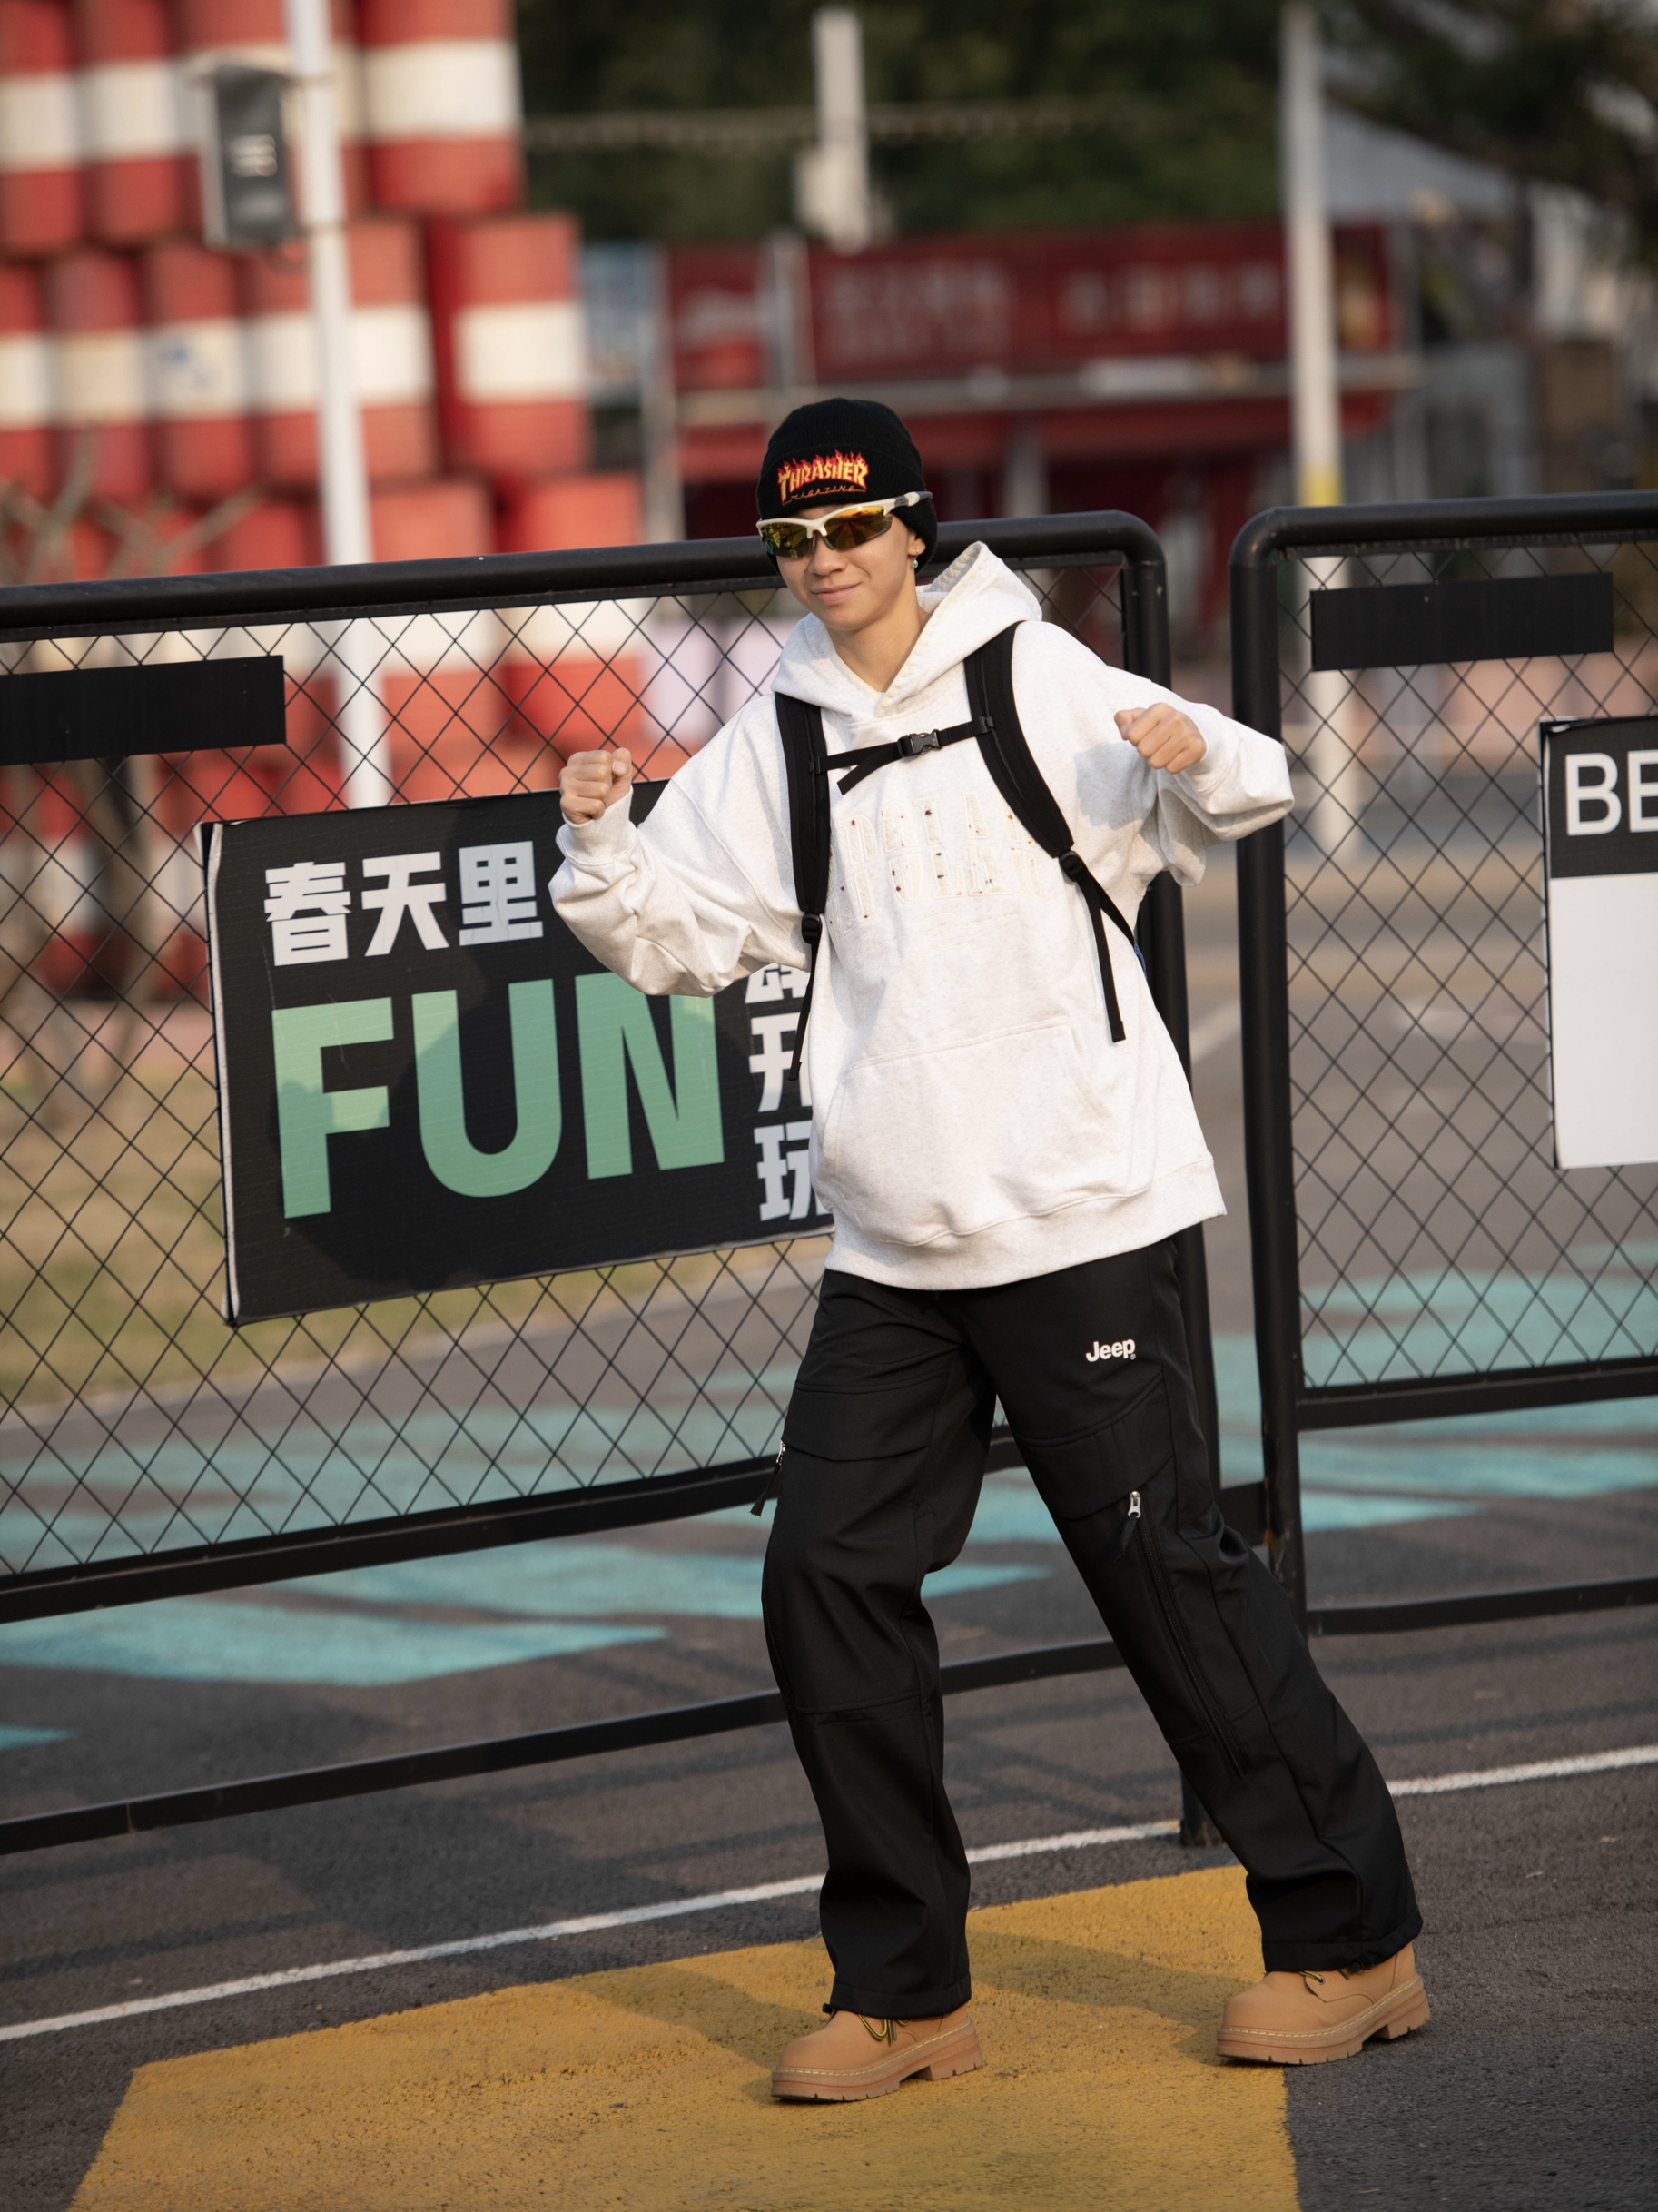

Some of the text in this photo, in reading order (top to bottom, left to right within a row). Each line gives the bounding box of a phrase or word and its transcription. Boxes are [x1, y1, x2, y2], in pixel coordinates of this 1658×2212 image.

[778, 449, 869, 505] THRASHER
[263, 840, 544, 966] 春天里
[272, 972, 725, 1219] FUN
[1085, 1338, 1136, 1362] Jeep
